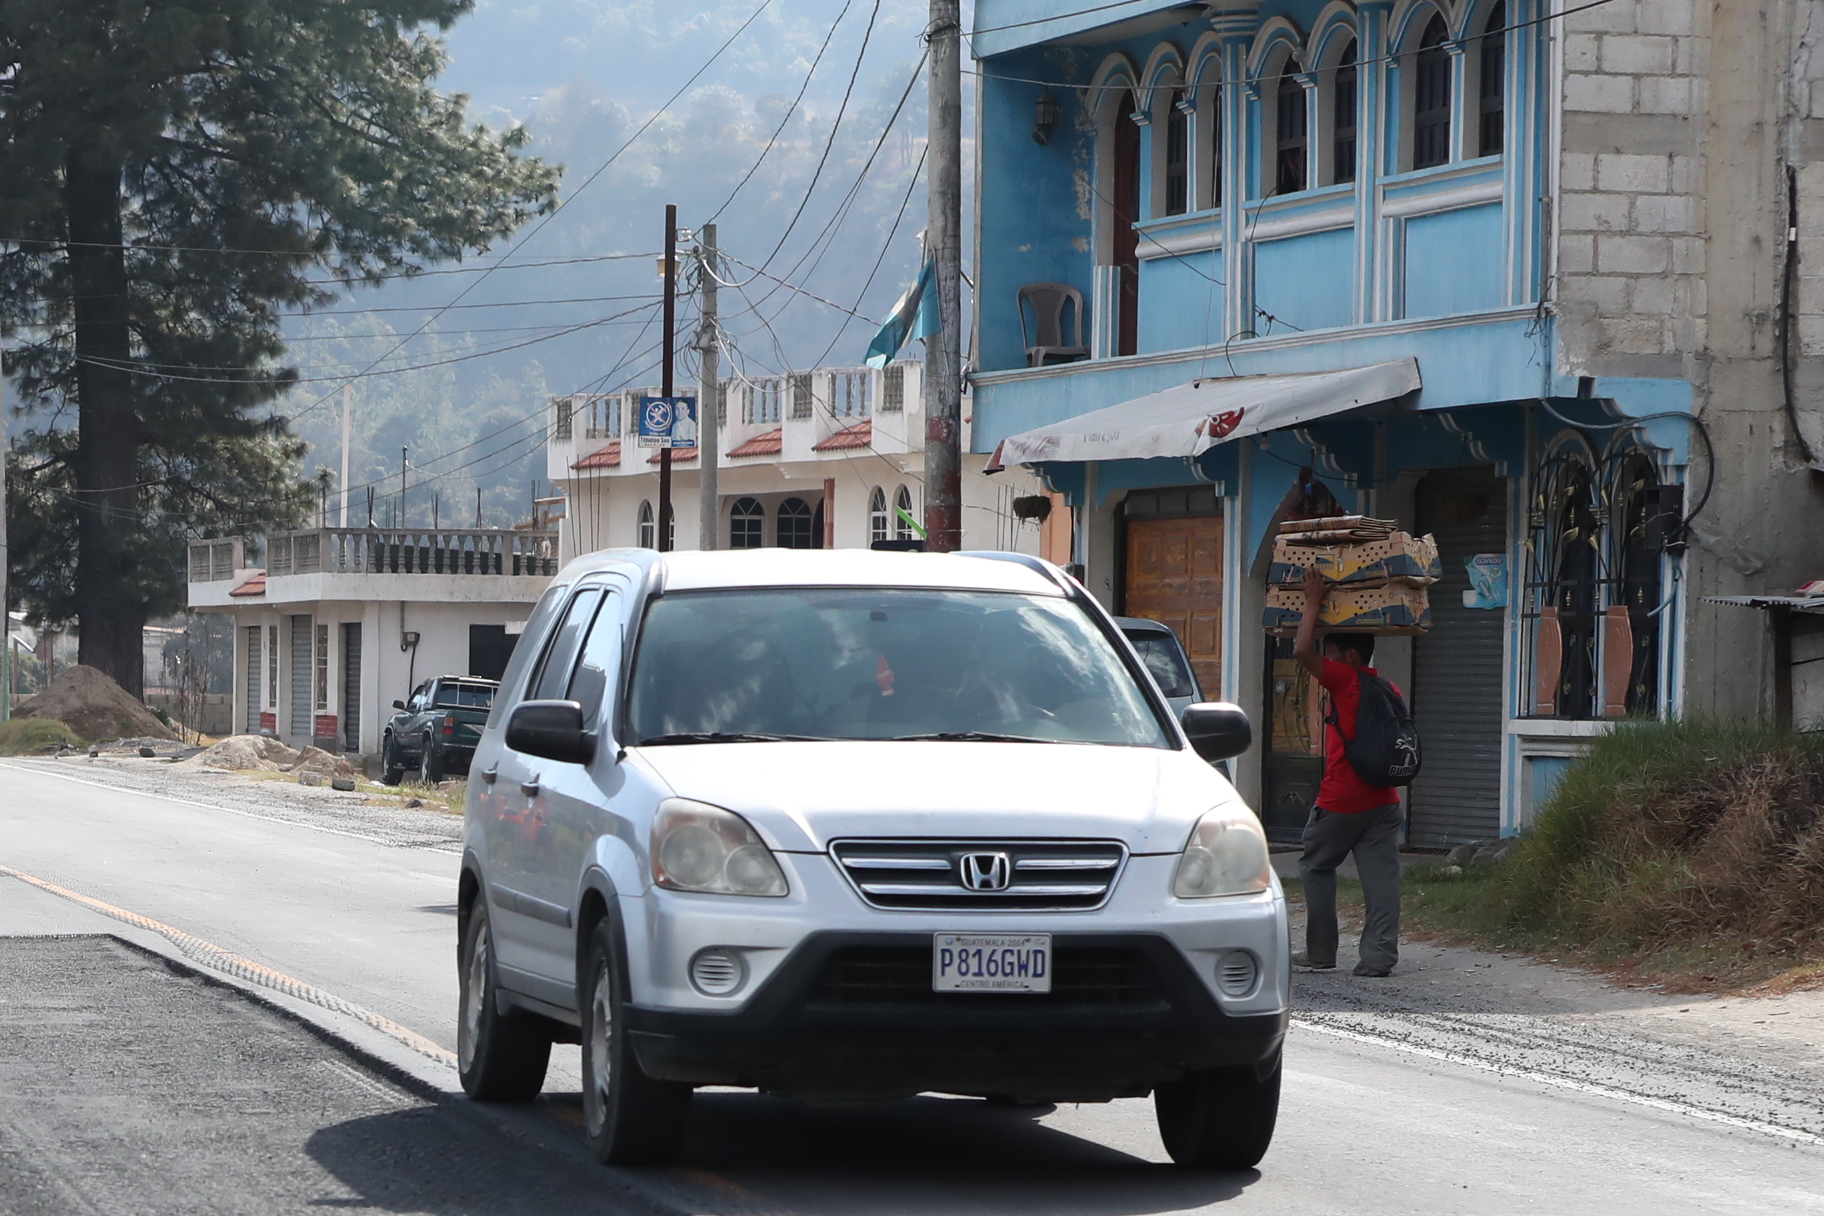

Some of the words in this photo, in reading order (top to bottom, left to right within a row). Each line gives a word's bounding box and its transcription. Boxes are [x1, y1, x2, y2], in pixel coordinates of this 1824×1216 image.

[961, 938, 1005, 946] GUATEMALA
[940, 948, 1046, 978] P816GWD
[960, 980, 988, 988] CENTRO
